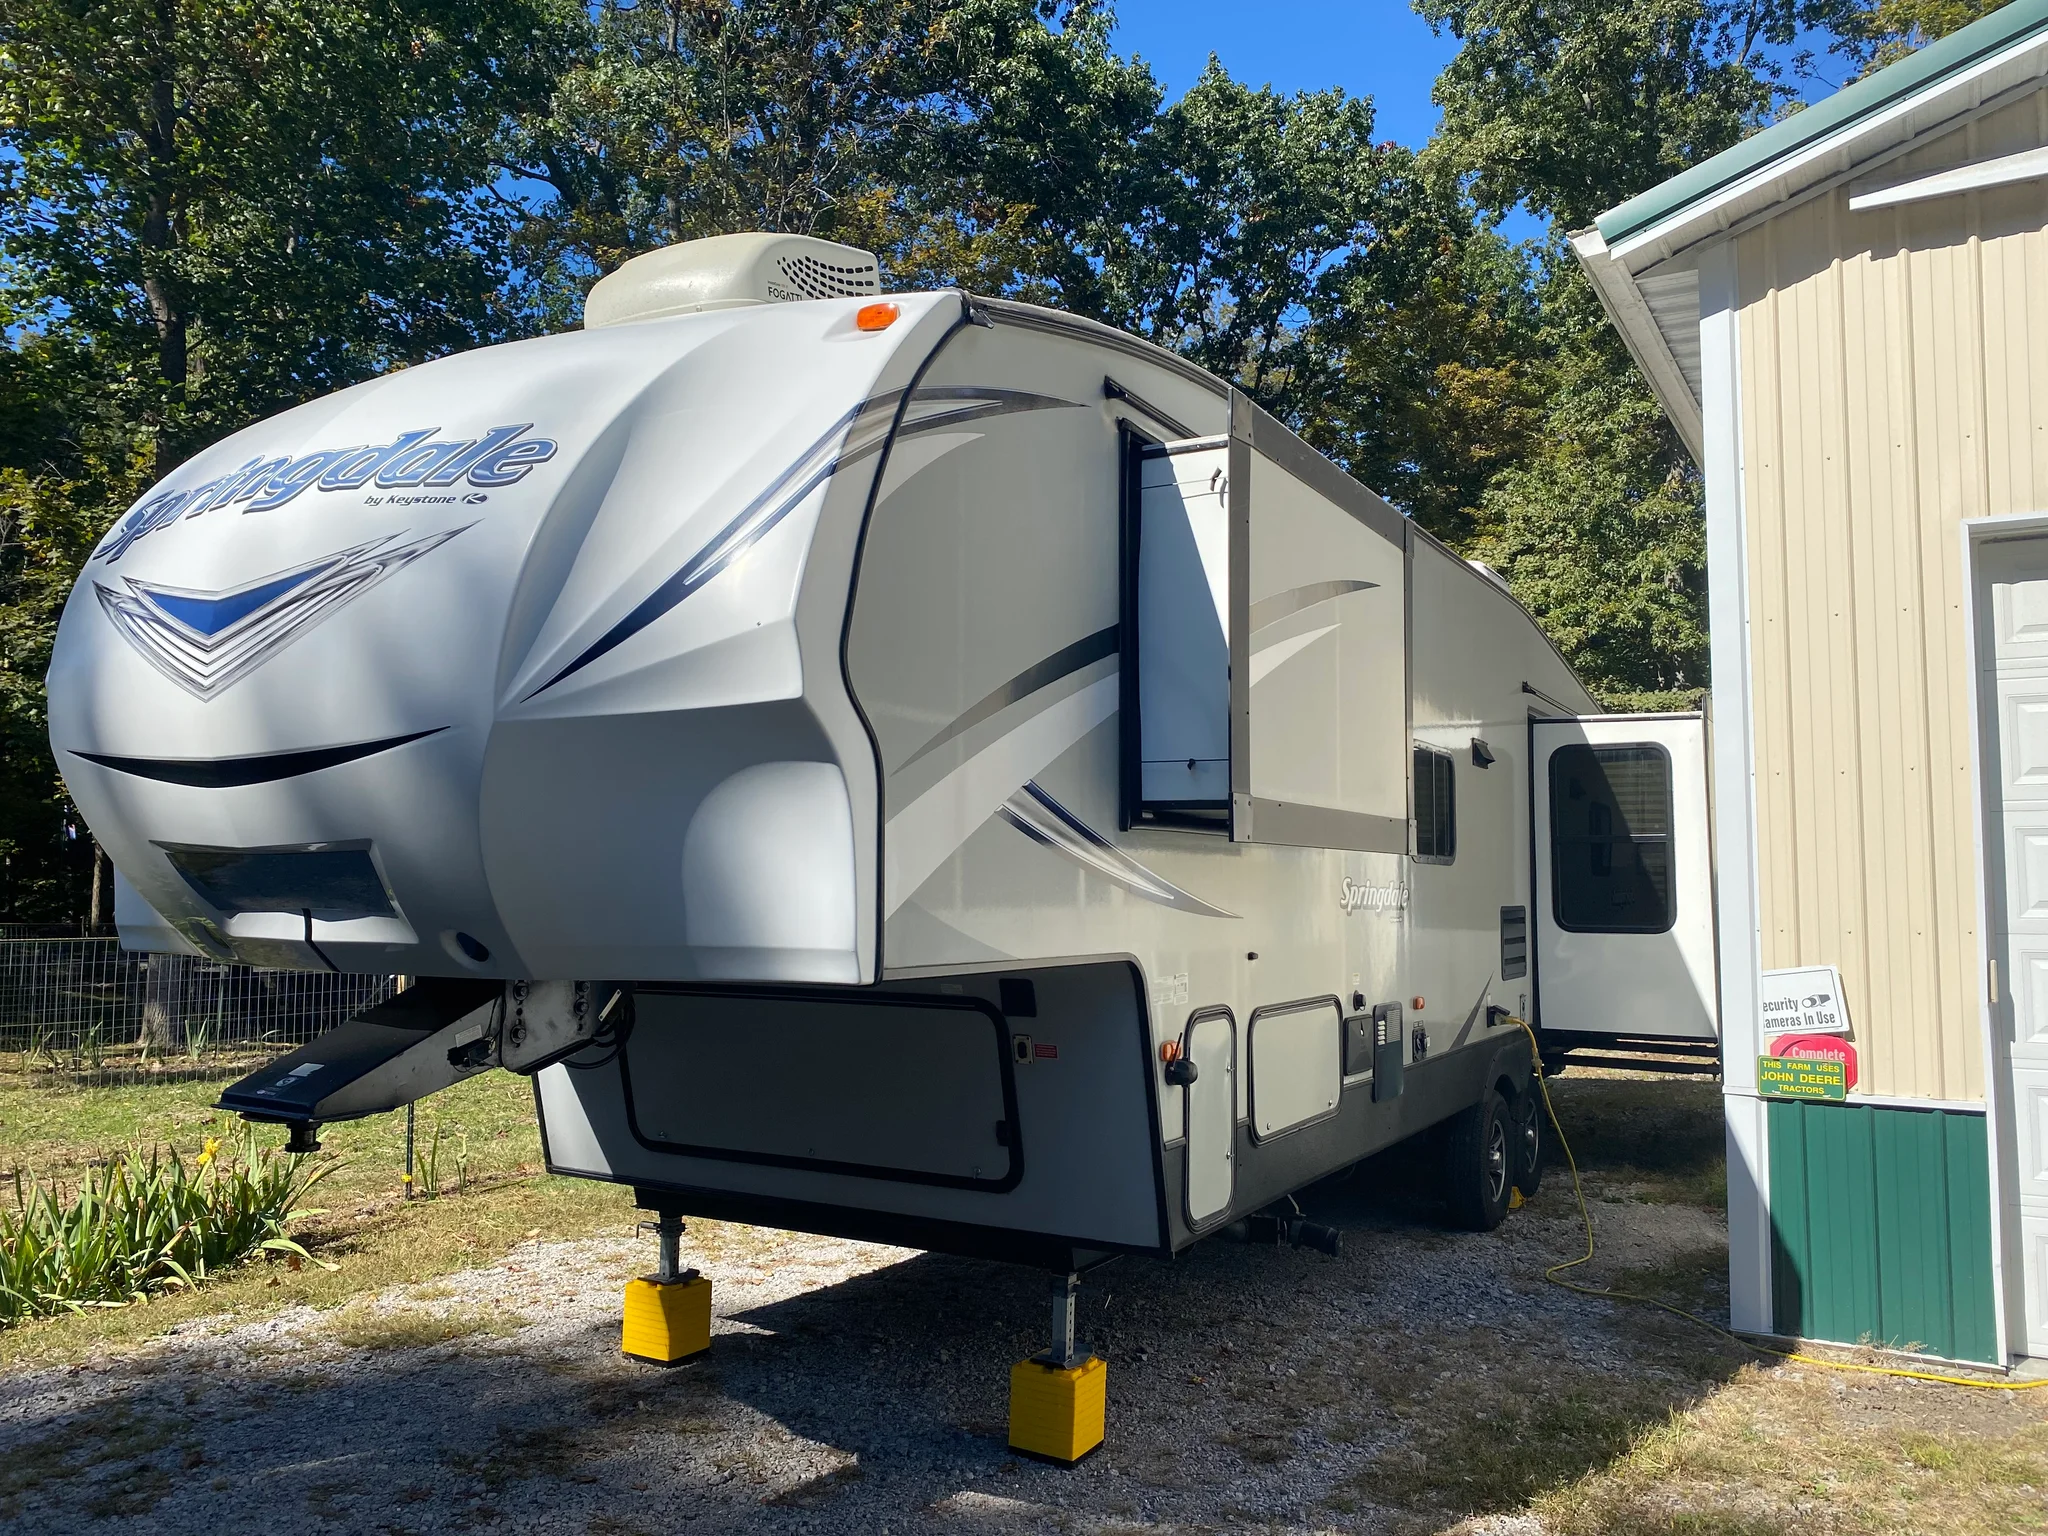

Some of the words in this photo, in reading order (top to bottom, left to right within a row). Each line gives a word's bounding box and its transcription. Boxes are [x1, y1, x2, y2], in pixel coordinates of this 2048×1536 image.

[767, 286, 803, 302] FOGATTI
[92, 423, 558, 565] Springdale
[364, 495, 384, 507] by
[386, 495, 457, 507] Keystone
[1340, 876, 1409, 916] Springdale
[1763, 997, 1798, 1012] ecurity
[1763, 1016, 1802, 1029] ameras
[1803, 1012, 1815, 1026] In
[1816, 1011, 1836, 1025] Use
[1792, 1046, 1846, 1061] Complete
[1762, 1060, 1782, 1069] THIS
[1787, 1062, 1811, 1071] FARM
[1816, 1064, 1840, 1073] USES
[1761, 1071, 1794, 1082] JOHN
[1800, 1073, 1841, 1086] DEERE
[1778, 1084, 1825, 1095] TRACTORS
